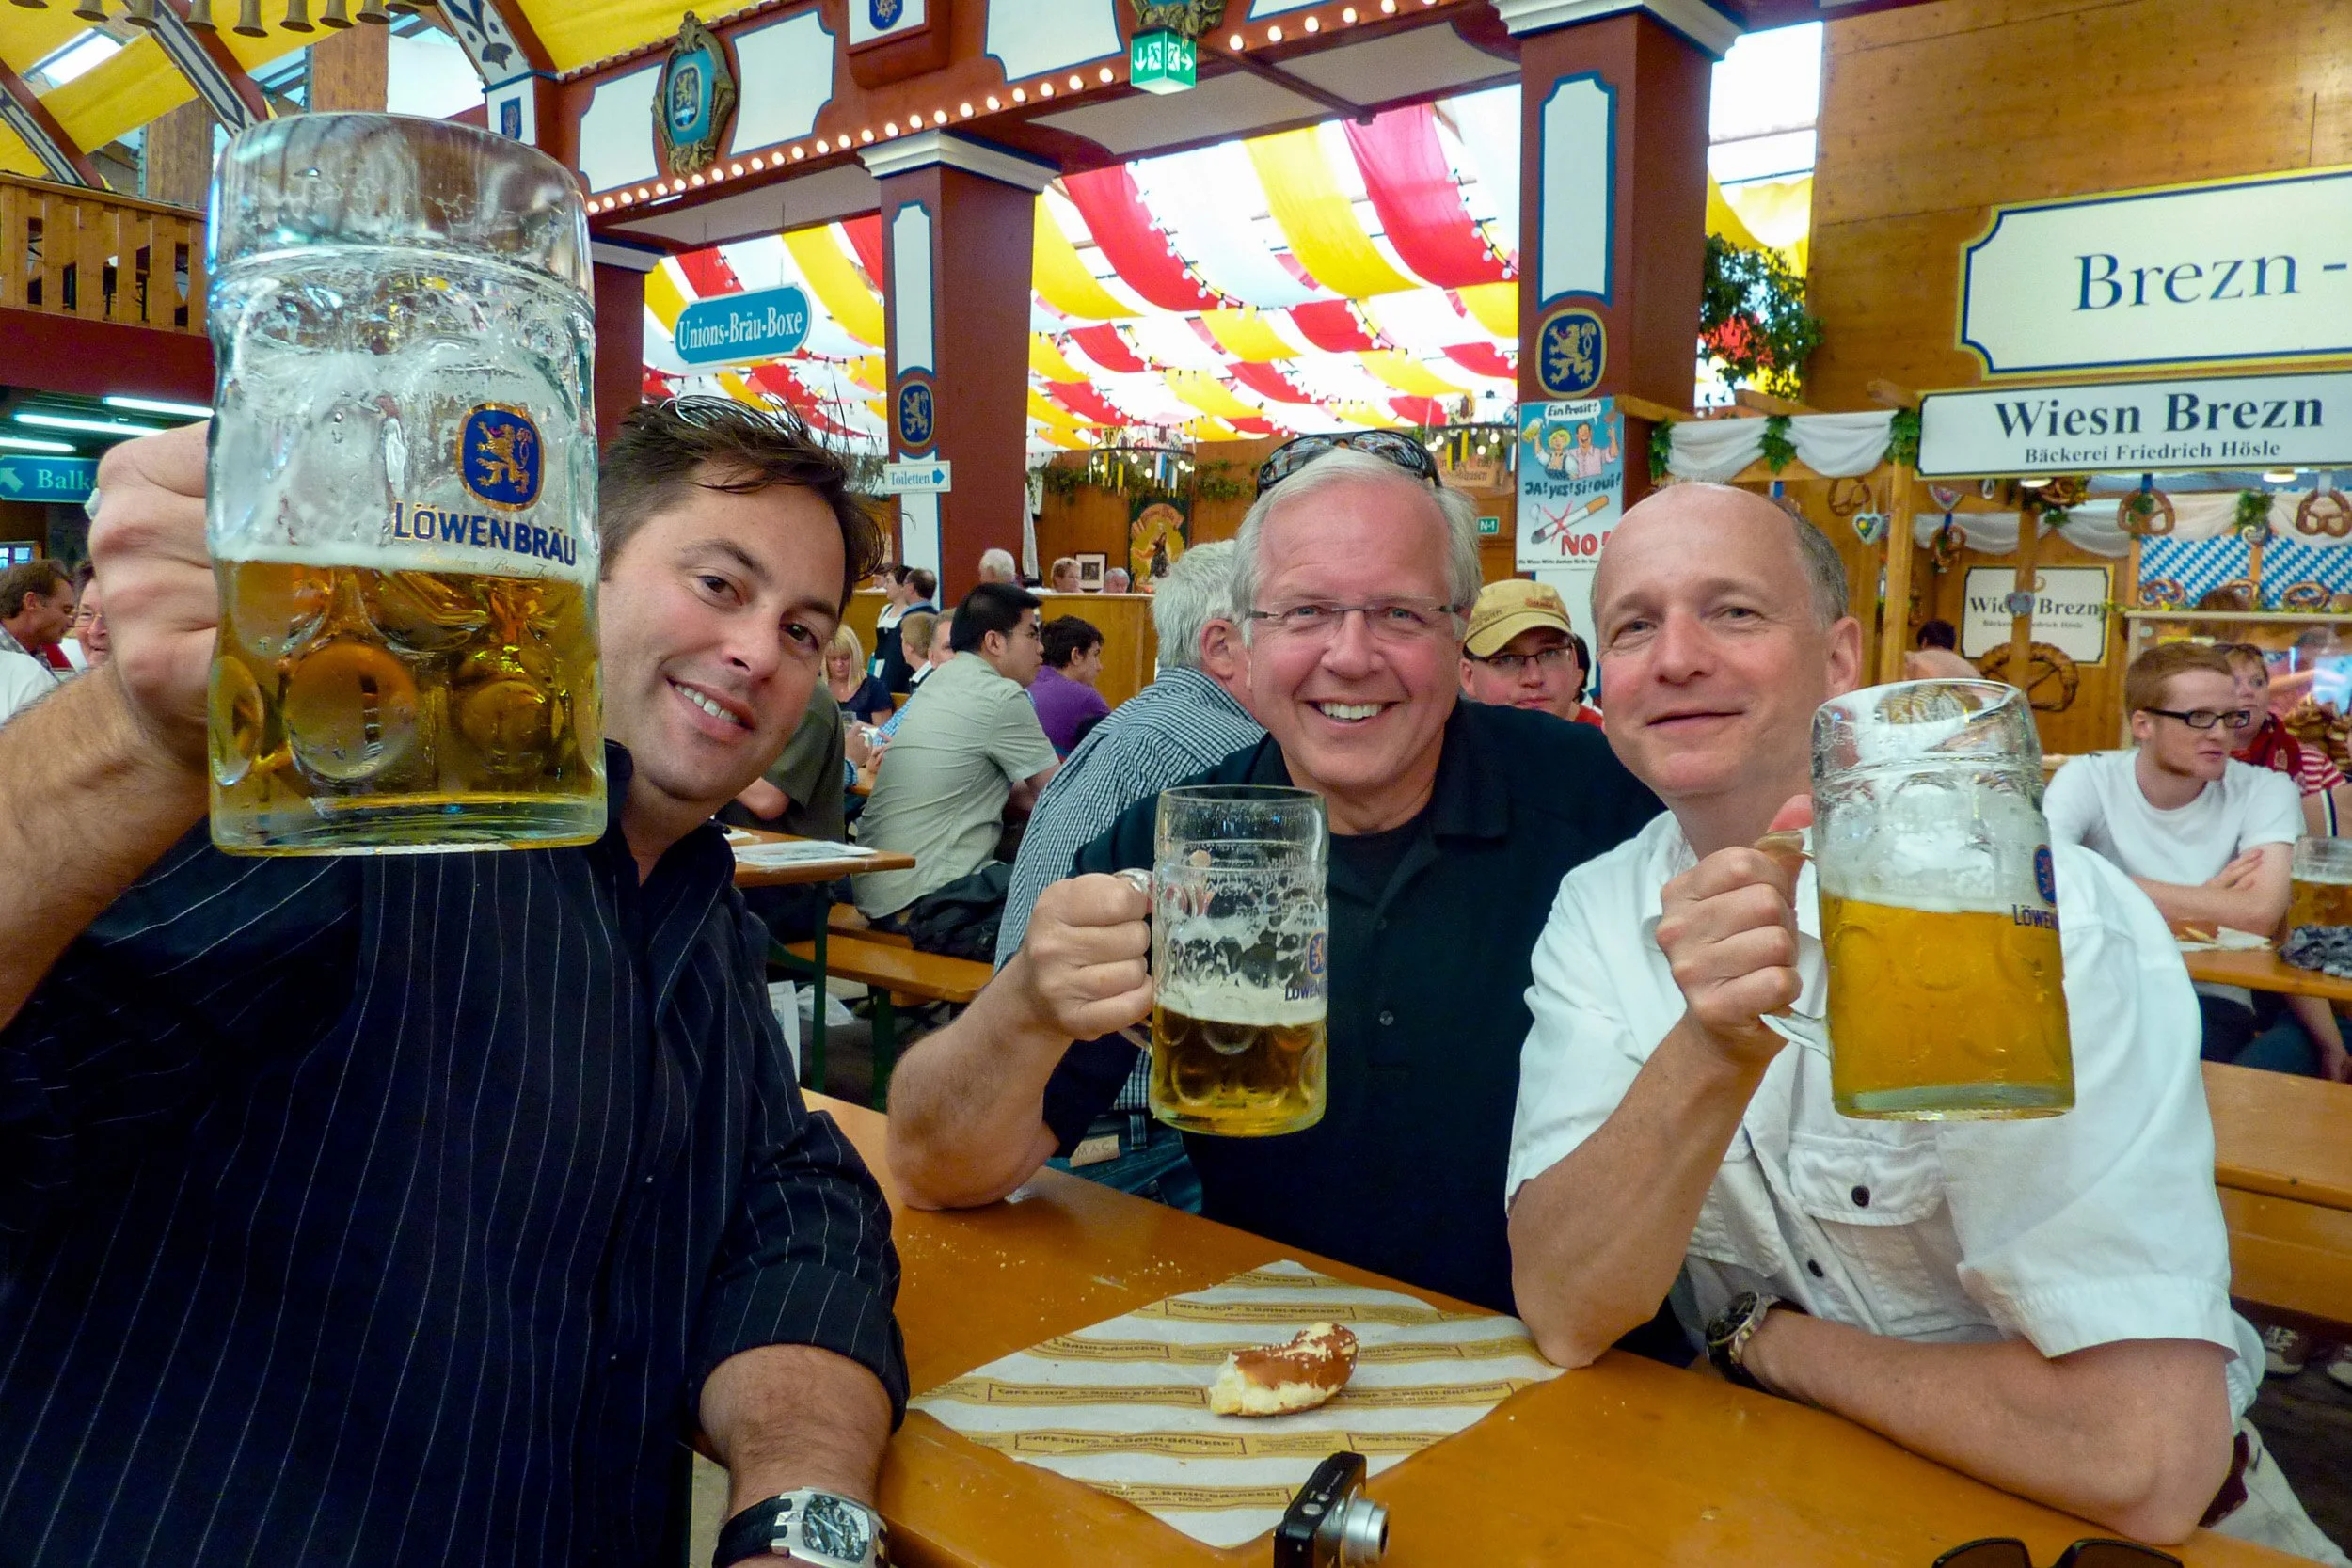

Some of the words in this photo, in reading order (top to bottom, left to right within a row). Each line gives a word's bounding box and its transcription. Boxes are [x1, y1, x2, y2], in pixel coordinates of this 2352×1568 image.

[2072, 250, 2301, 312] Brezn
[678, 306, 803, 351] Unions-Bräu-Boxe
[1548, 404, 1564, 417] Ein
[1565, 402, 1598, 416] Prosit!
[1994, 399, 2141, 439] Wiesn
[2166, 392, 2324, 432] Brezn
[2025, 446, 2108, 464] Bäckerei
[2116, 442, 2213, 461] Friedrich
[2221, 440, 2281, 458] Hösle
[37, 468, 97, 490] Balk
[889, 470, 930, 487] Toiletten
[393, 501, 578, 567] LÖWENBRÄU
[1970, 596, 2011, 614] Wie
[2039, 597, 2099, 616] Brezn
